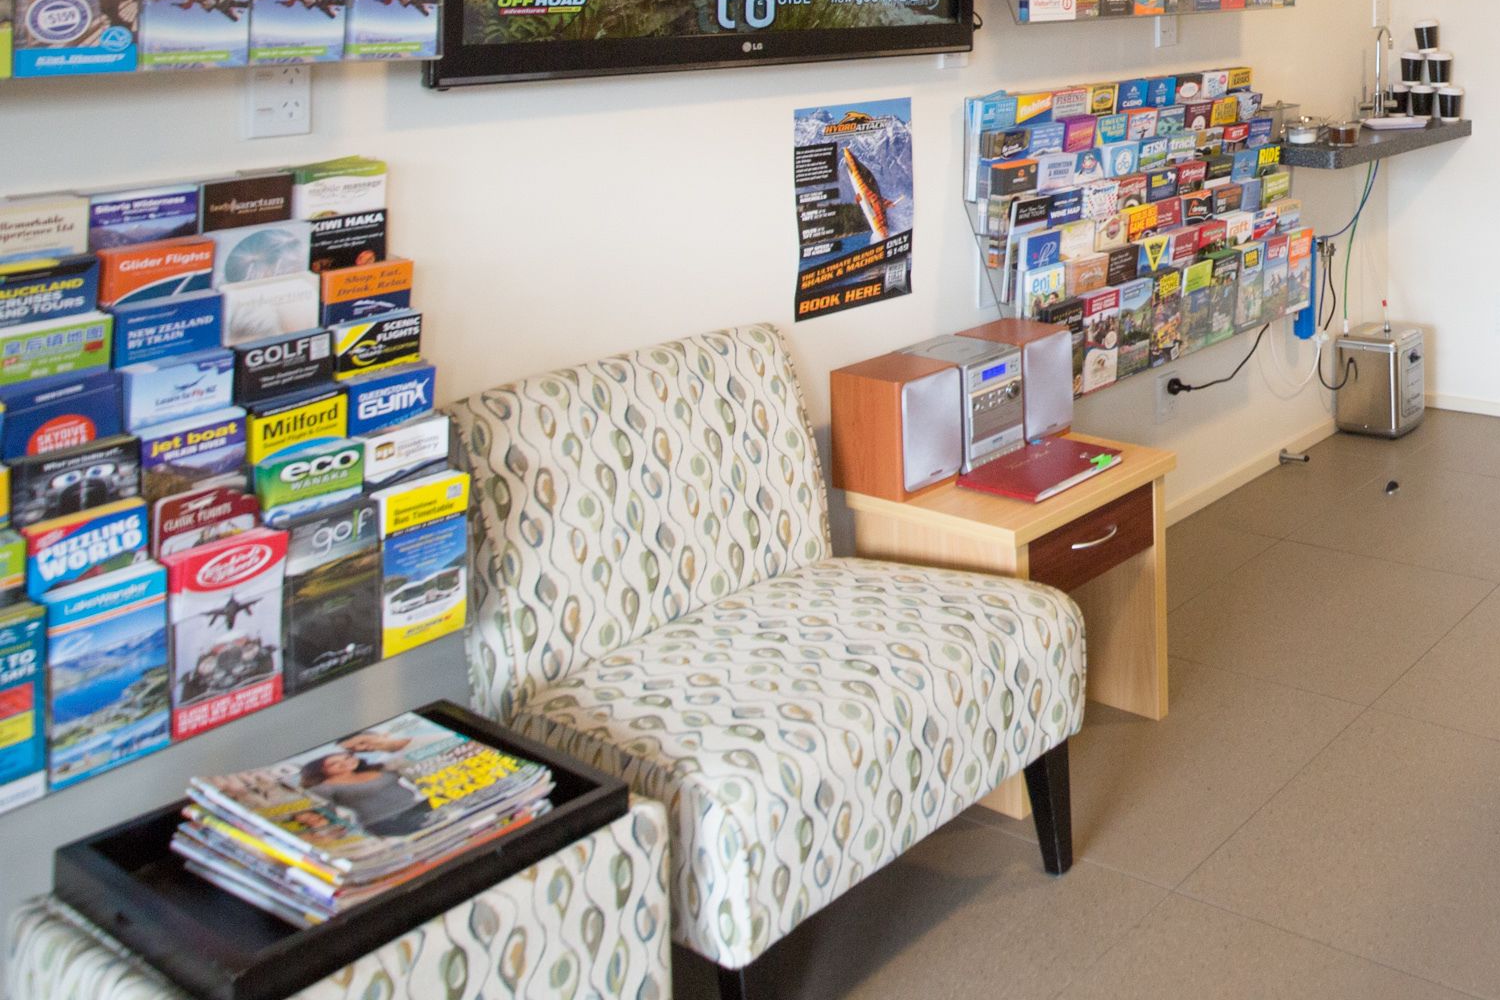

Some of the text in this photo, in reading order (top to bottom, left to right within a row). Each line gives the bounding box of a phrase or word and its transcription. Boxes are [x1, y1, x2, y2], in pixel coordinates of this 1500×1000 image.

[752, 42, 763, 50] LG
[1259, 147, 1280, 164] RIDE
[311, 212, 385, 232] KIWI HAKA
[886, 235, 909, 248] ONLY
[119, 251, 210, 272] Glider Flights
[801, 273, 834, 289] SHARK
[846, 252, 885, 271] MACHINE
[0, 278, 84, 299] AUCKLAND
[799, 284, 882, 314] BOOK HERE
[32, 296, 84, 312] TOURS
[128, 315, 214, 341] NEW ZEALAND
[376, 326, 420, 342] FLIGHTS
[383, 316, 420, 332] SCENIC
[127, 330, 185, 350] BY TRAIN
[246, 337, 311, 368] GOLF
[358, 391, 412, 421] GYM
[263, 403, 338, 440] Milford
[37, 423, 87, 445] SKYDIVE
[151, 421, 238, 457] jet boat
[199, 437, 228, 450] RIVER
[281, 450, 360, 483] eco
[291, 469, 349, 491] WANAKA
[37, 514, 141, 563] PUZZLING
[312, 507, 374, 555] golf
[37, 529, 142, 580] WORLD
